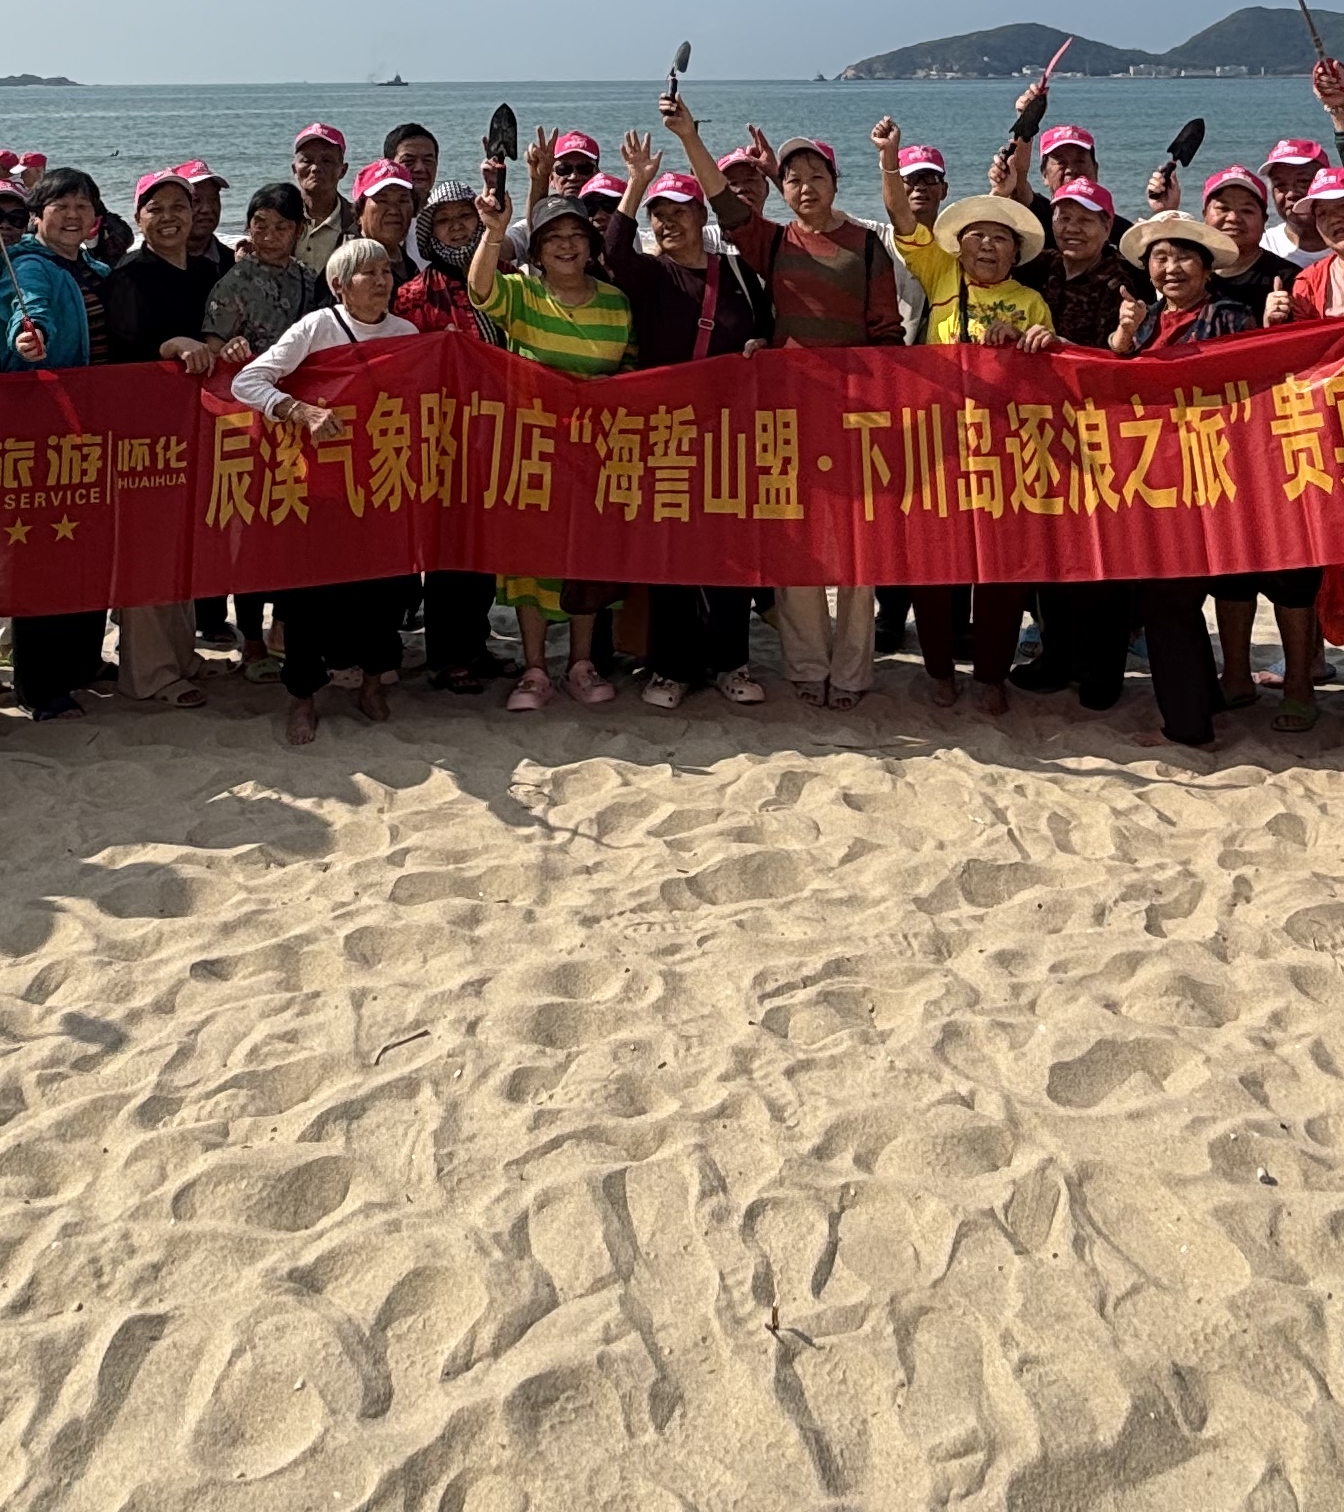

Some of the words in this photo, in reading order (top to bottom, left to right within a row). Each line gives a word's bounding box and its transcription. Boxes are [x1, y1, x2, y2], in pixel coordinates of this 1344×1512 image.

[117, 435, 188, 472] 怀化
[117, 473, 187, 490] HUAIHUA
[4, 487, 101, 510] SERVICE
